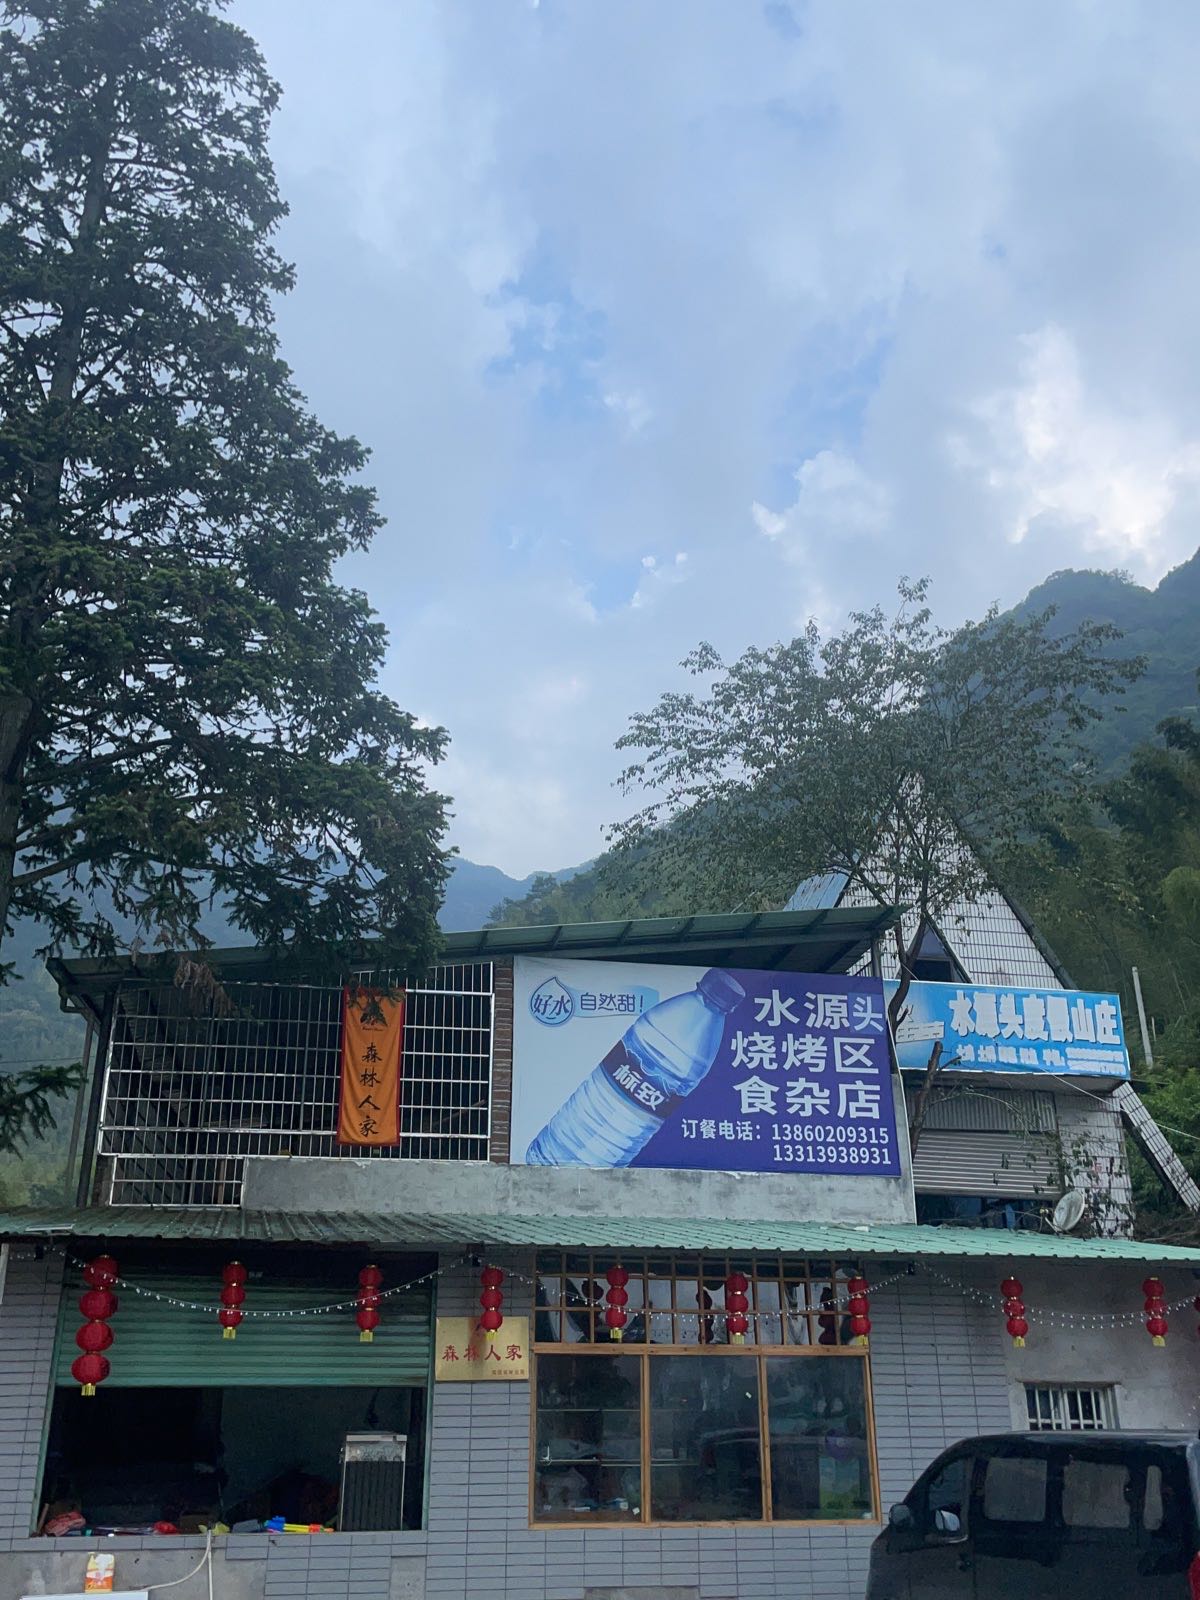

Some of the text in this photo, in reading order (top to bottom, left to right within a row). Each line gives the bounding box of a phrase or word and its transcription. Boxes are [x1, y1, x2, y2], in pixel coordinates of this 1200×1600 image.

[533, 993, 571, 1016] 好水
[580, 992, 644, 1014] 自然甜！
[753, 989, 885, 1034] 水源头
[730, 1031, 880, 1075] 烧烤区
[358, 1042, 383, 1138] 森林人家
[612, 1064, 665, 1111] 标致
[732, 1075, 882, 1120] 食杂店
[681, 1118, 890, 1145] 订餐电话： 13860209315
[773, 1144, 892, 1165] 13313938931
[441, 1344, 523, 1362] 森林人家
